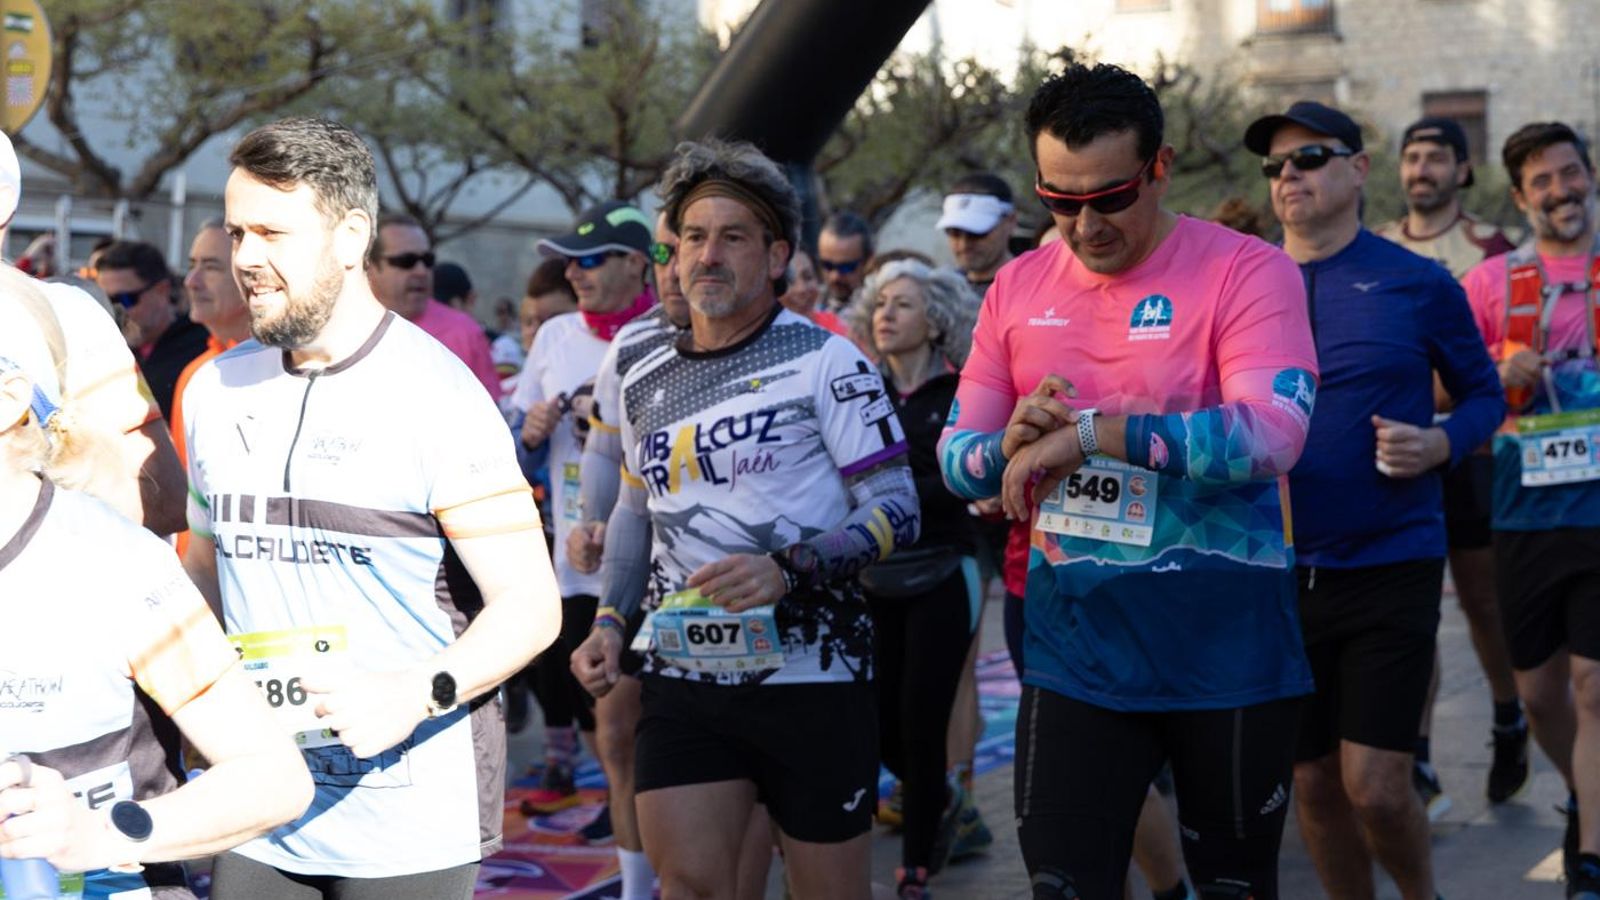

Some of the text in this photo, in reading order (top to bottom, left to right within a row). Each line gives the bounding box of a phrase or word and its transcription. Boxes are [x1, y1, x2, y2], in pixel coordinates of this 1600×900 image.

[1545, 438, 1587, 458] 476
[729, 447, 781, 493] Jaén
[1065, 473, 1120, 504] 549
[686, 623, 741, 645] 607
[254, 677, 307, 708] 86
